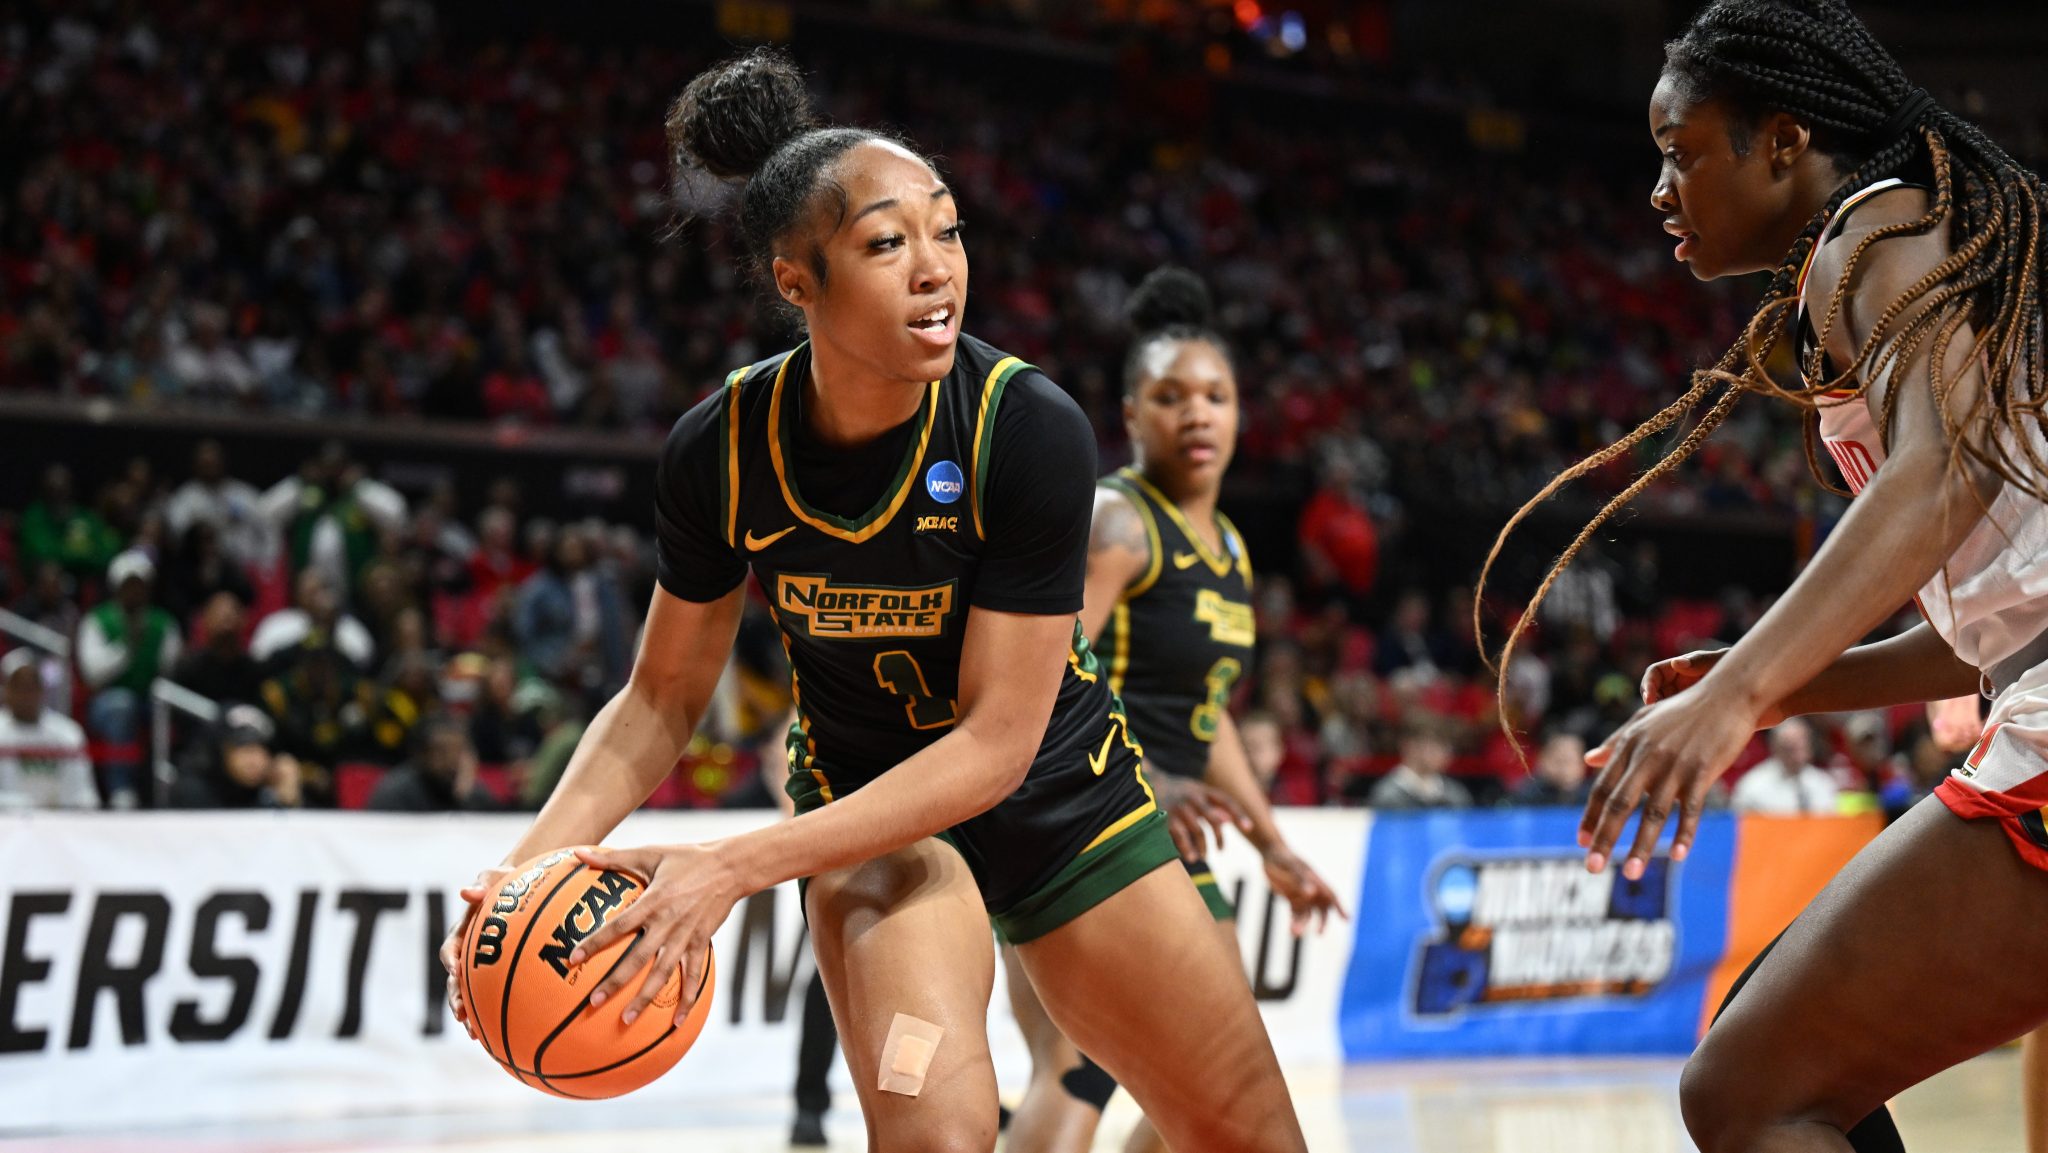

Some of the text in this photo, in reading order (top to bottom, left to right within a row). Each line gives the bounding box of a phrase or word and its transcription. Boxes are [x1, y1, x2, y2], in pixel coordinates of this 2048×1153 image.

[931, 480, 961, 493] NCAA
[917, 516, 958, 532] MEAC
[784, 581, 944, 611] NORFOLK
[815, 611, 936, 633] STATE
[854, 626, 936, 634] SPARTANS
[872, 650, 958, 730] 1
[538, 869, 638, 980] NCAA
